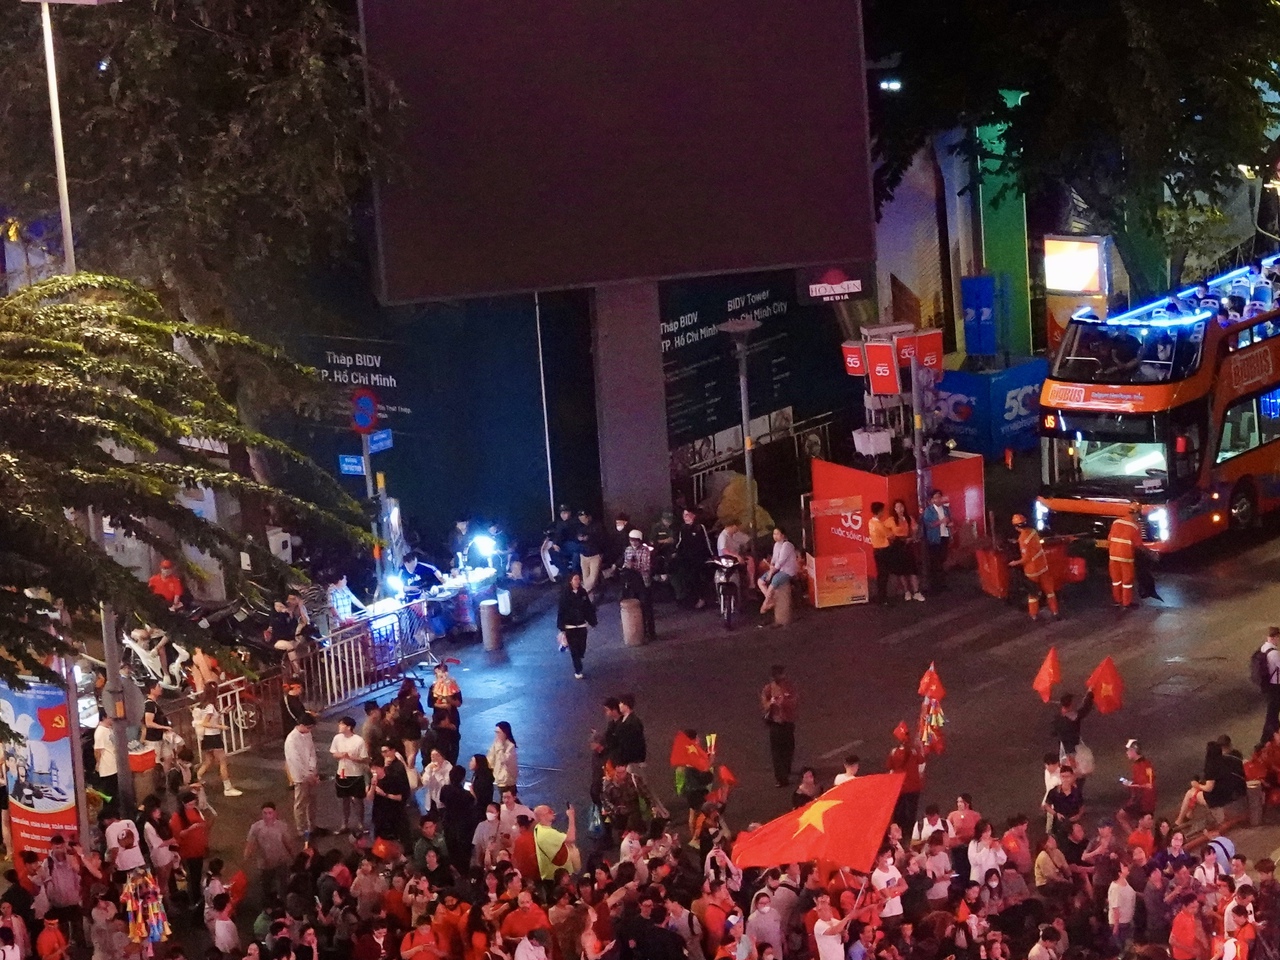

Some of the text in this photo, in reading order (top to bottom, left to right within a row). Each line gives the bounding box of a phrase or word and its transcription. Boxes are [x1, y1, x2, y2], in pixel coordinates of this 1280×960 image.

[727, 289, 770, 312] BIDV Tower
[823, 294, 849, 302] MEDIA
[773, 300, 788, 314] City
[679, 311, 698, 328] BIDV
[325, 351, 381, 367] Tháp BIDV
[846, 357, 860, 368] 5G
[875, 366, 890, 376] 5G
[370, 373, 397, 388] Minh
